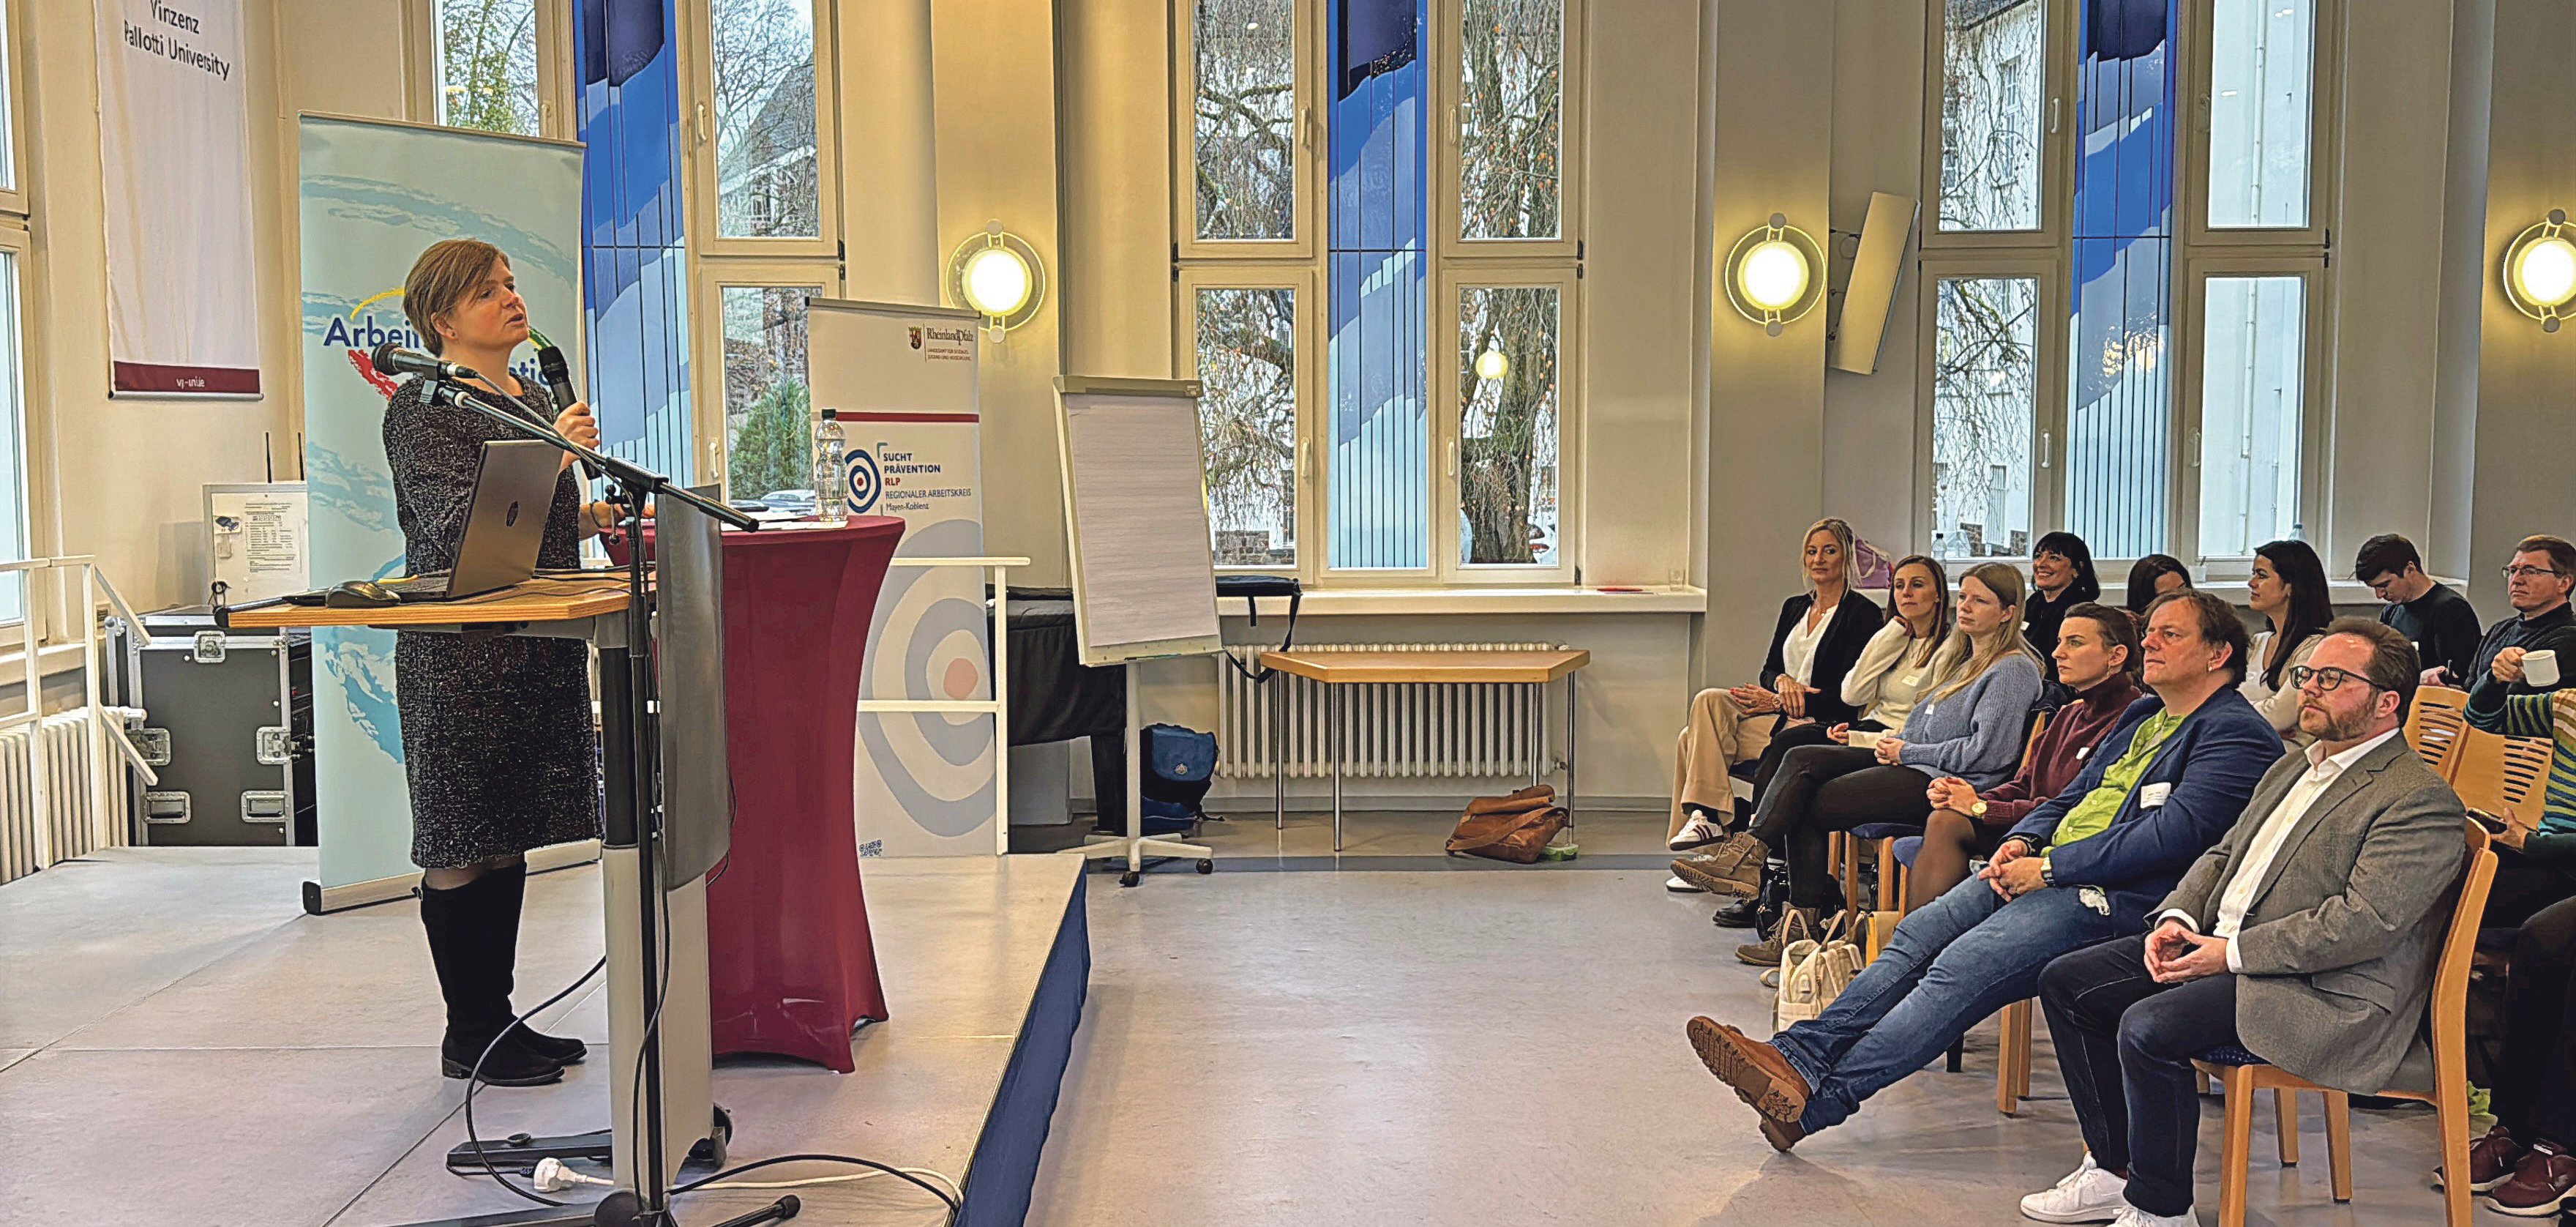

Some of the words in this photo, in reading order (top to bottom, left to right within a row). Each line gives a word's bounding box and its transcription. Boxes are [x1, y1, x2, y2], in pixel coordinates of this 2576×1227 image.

[150, 0, 200, 34] Vinzenz
[124, 20, 164, 56] Pallotti
[168, 37, 231, 81] University
[883, 453, 913, 462] SUCHT
[884, 463, 941, 474] PRÄVENTION
[885, 477, 901, 486] RLP
[886, 490, 927, 499] REGIONALER
[928, 488, 972, 498] ARBEITSKREIS
[886, 501, 929, 512] Mayen-Koblenz
